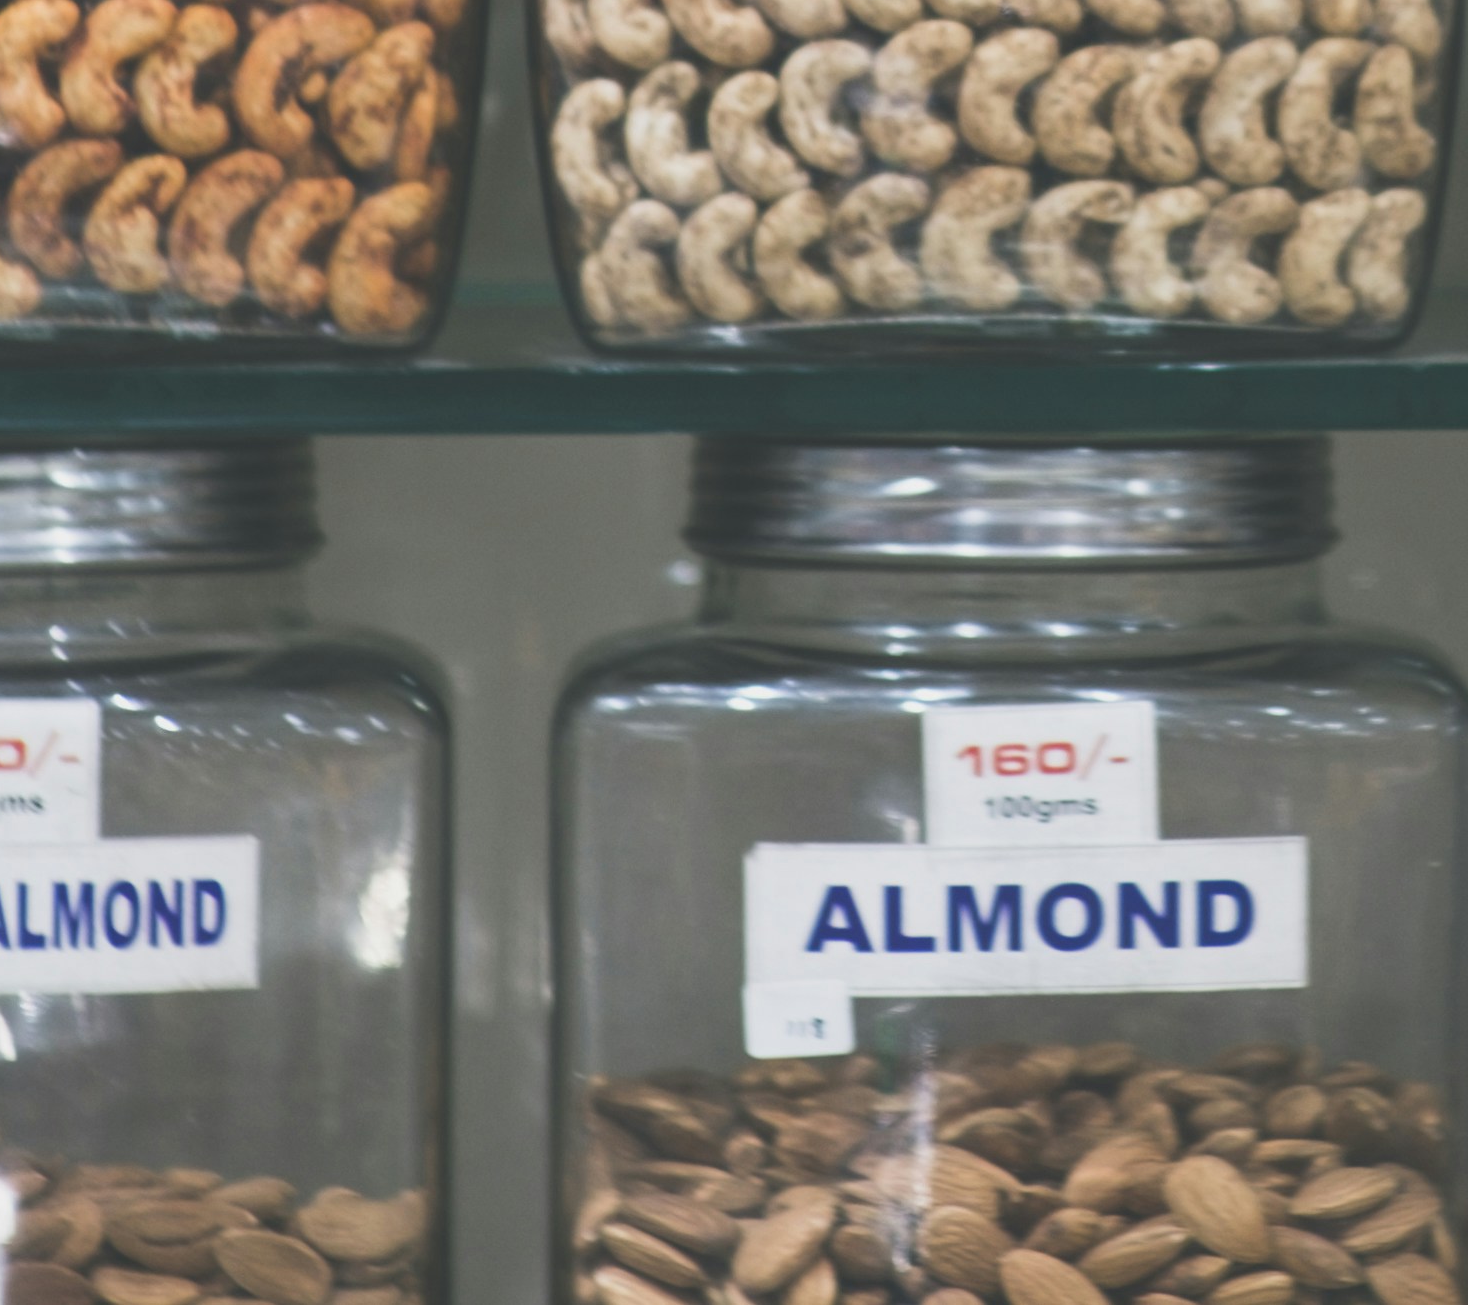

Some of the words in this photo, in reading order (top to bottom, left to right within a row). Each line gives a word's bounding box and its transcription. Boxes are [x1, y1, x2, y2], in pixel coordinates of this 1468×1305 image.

[954, 741, 1128, 779] 160/-
[984, 794, 1100, 824] 100gms
[804, 878, 1256, 954] ALMOND
